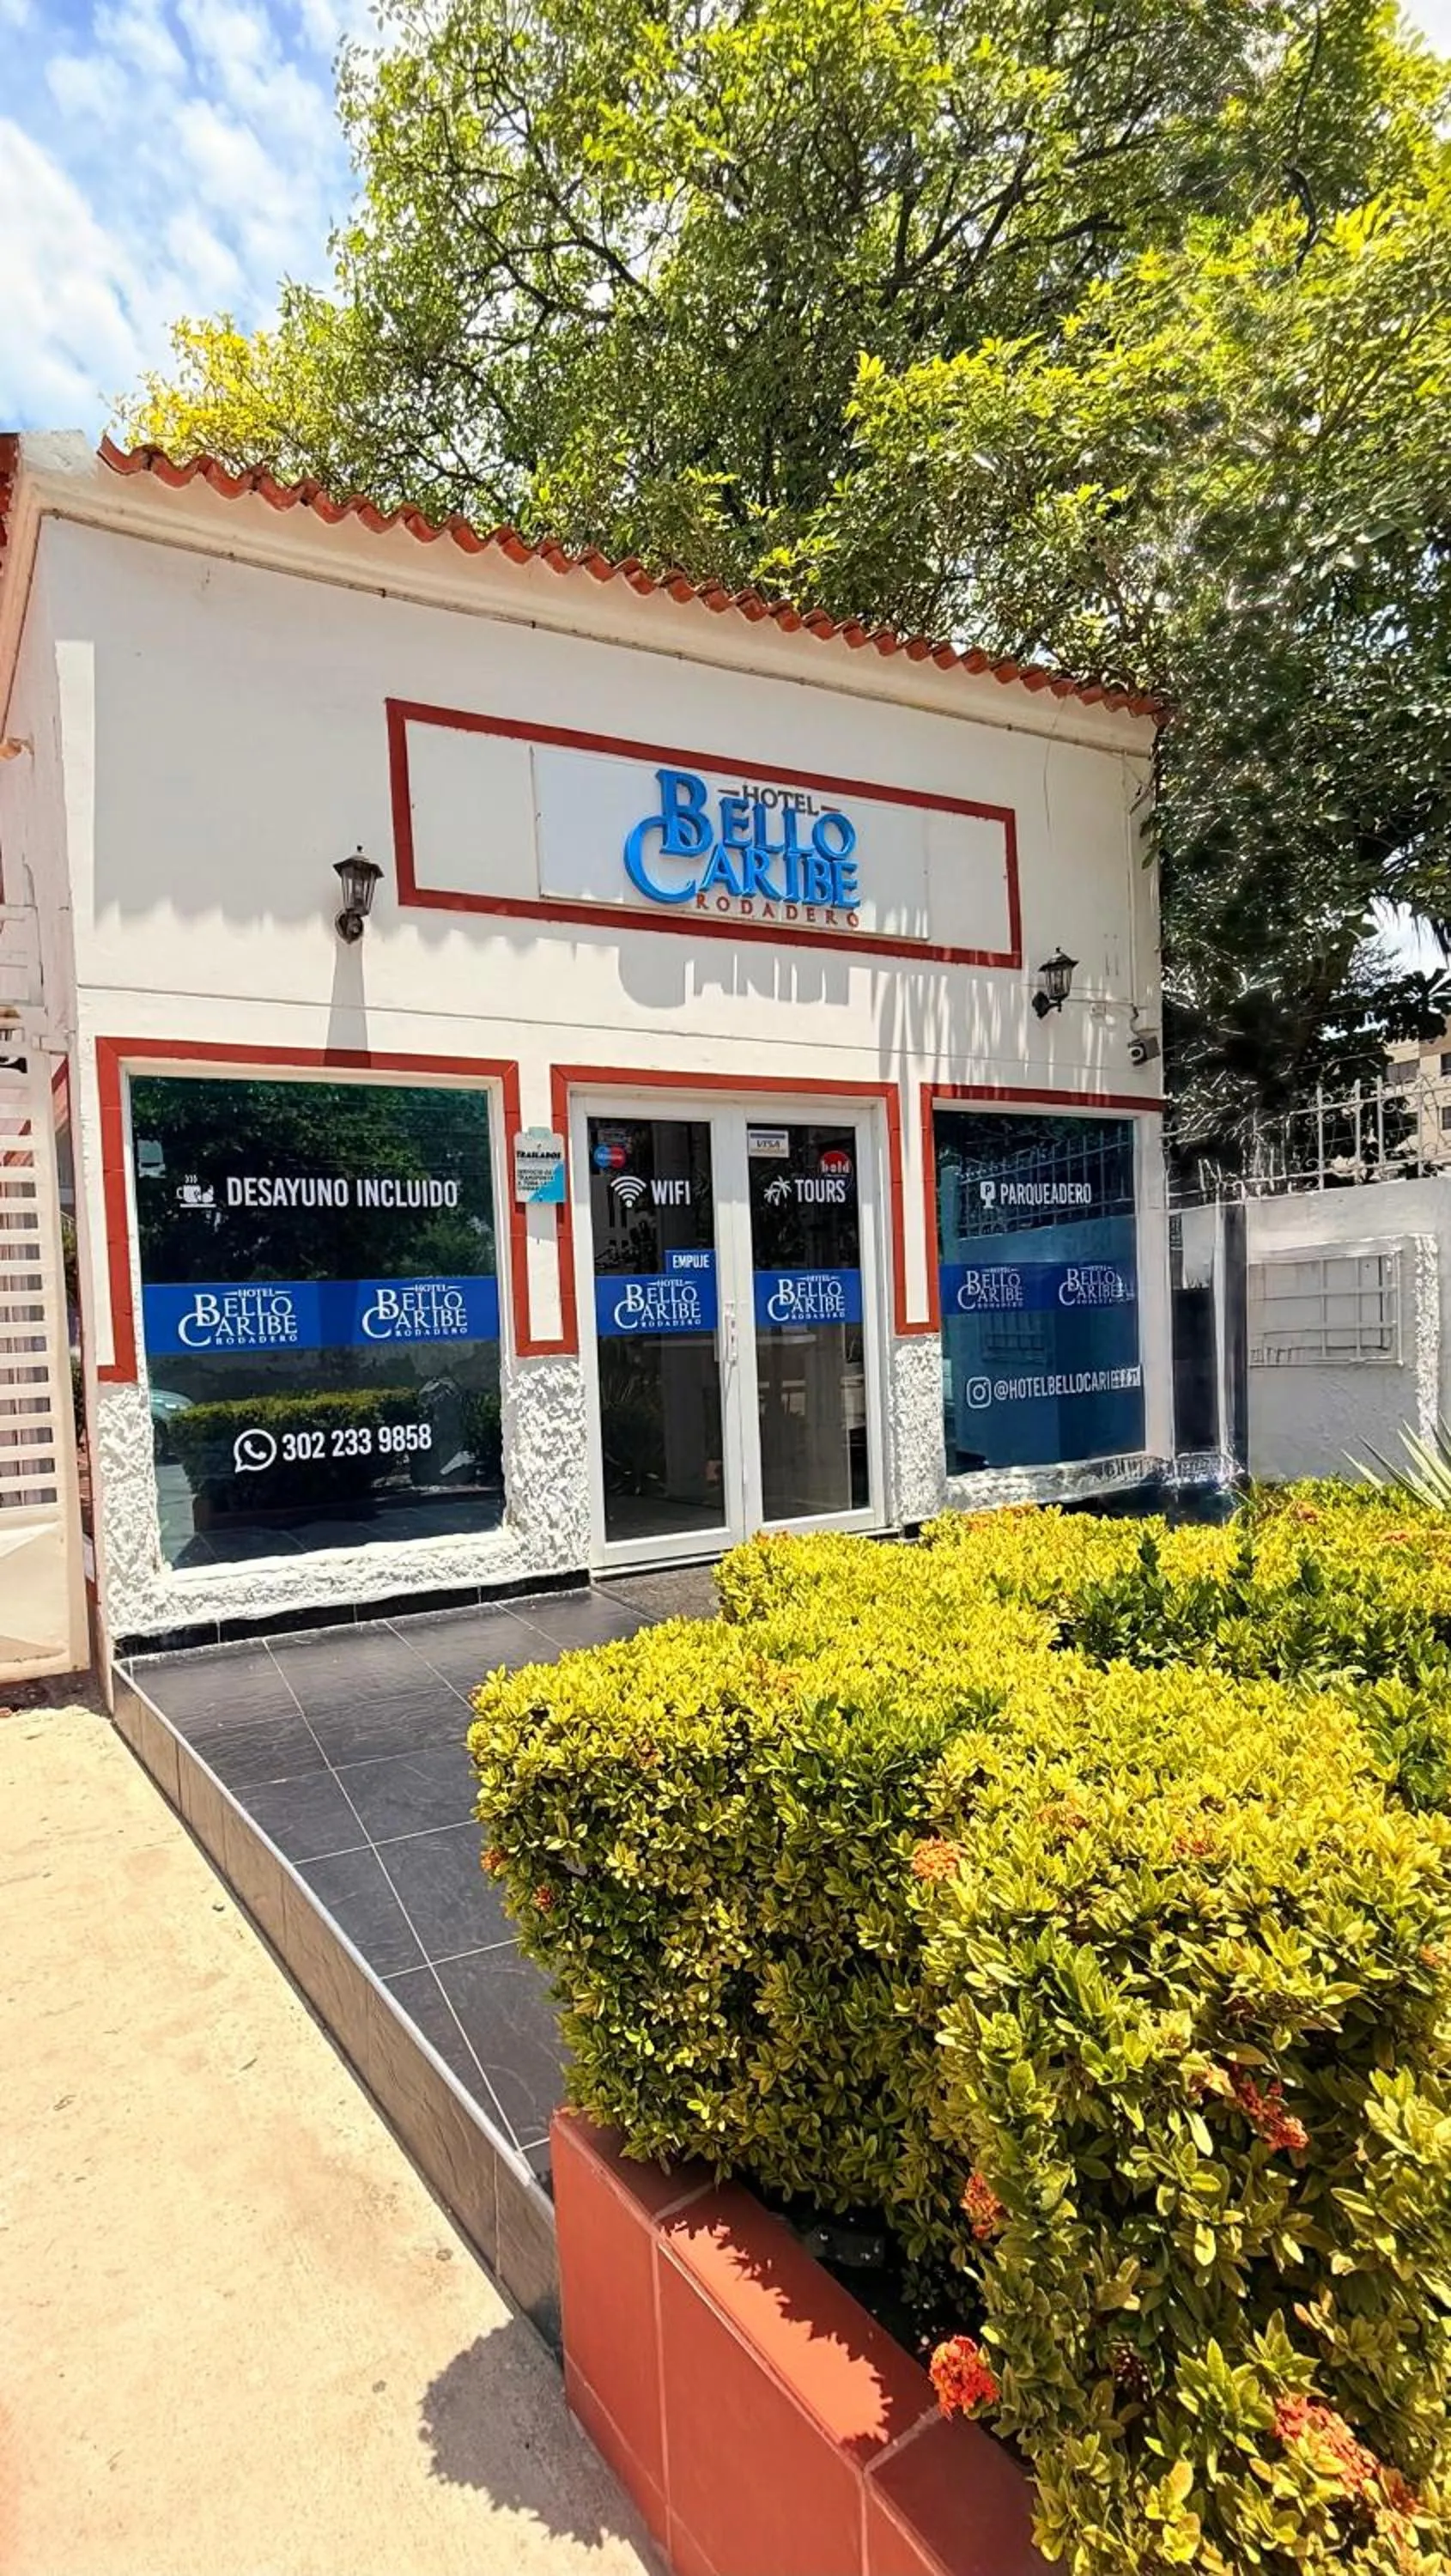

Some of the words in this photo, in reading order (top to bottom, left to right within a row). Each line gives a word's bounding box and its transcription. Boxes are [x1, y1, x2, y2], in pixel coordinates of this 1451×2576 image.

[742, 784, 820, 816] HOTEL
[655, 769, 857, 861] BELLO
[623, 815, 861, 909] CARIBE
[695, 892, 859, 928] RODADERO
[227, 1176, 349, 1207] DESAYUNO
[356, 1179, 458, 1208] INCLUIDO
[650, 1179, 691, 1206] WIFI
[794, 1178, 846, 1203] TOURS
[1000, 1182, 1092, 1206] PARQUEADERO
[672, 1255, 710, 1268] EMPUJE
[238, 1288, 275, 1297] HOTEL
[415, 1284, 446, 1292] HOTEL
[778, 1279, 842, 1305] BELLO
[967, 1270, 1021, 1295] BELLO
[1067, 1268, 1115, 1291] BELLO
[194, 1293, 292, 1327] BELLO
[376, 1289, 463, 1320] BELLO
[625, 1284, 697, 1312] BELLO
[767, 1294, 846, 1321] CARIBE
[957, 1285, 1023, 1309] CARIBE
[361, 1306, 468, 1339] CARIBE
[614, 1300, 701, 1329] CARIBE
[178, 1313, 298, 1347] CARIBE
[216, 1334, 298, 1346] RODADERO
[395, 1327, 468, 1337] RODADERO
[282, 1431, 325, 1461] 302
[331, 1427, 372, 1457] 233
[378, 1423, 432, 1453] 9858
